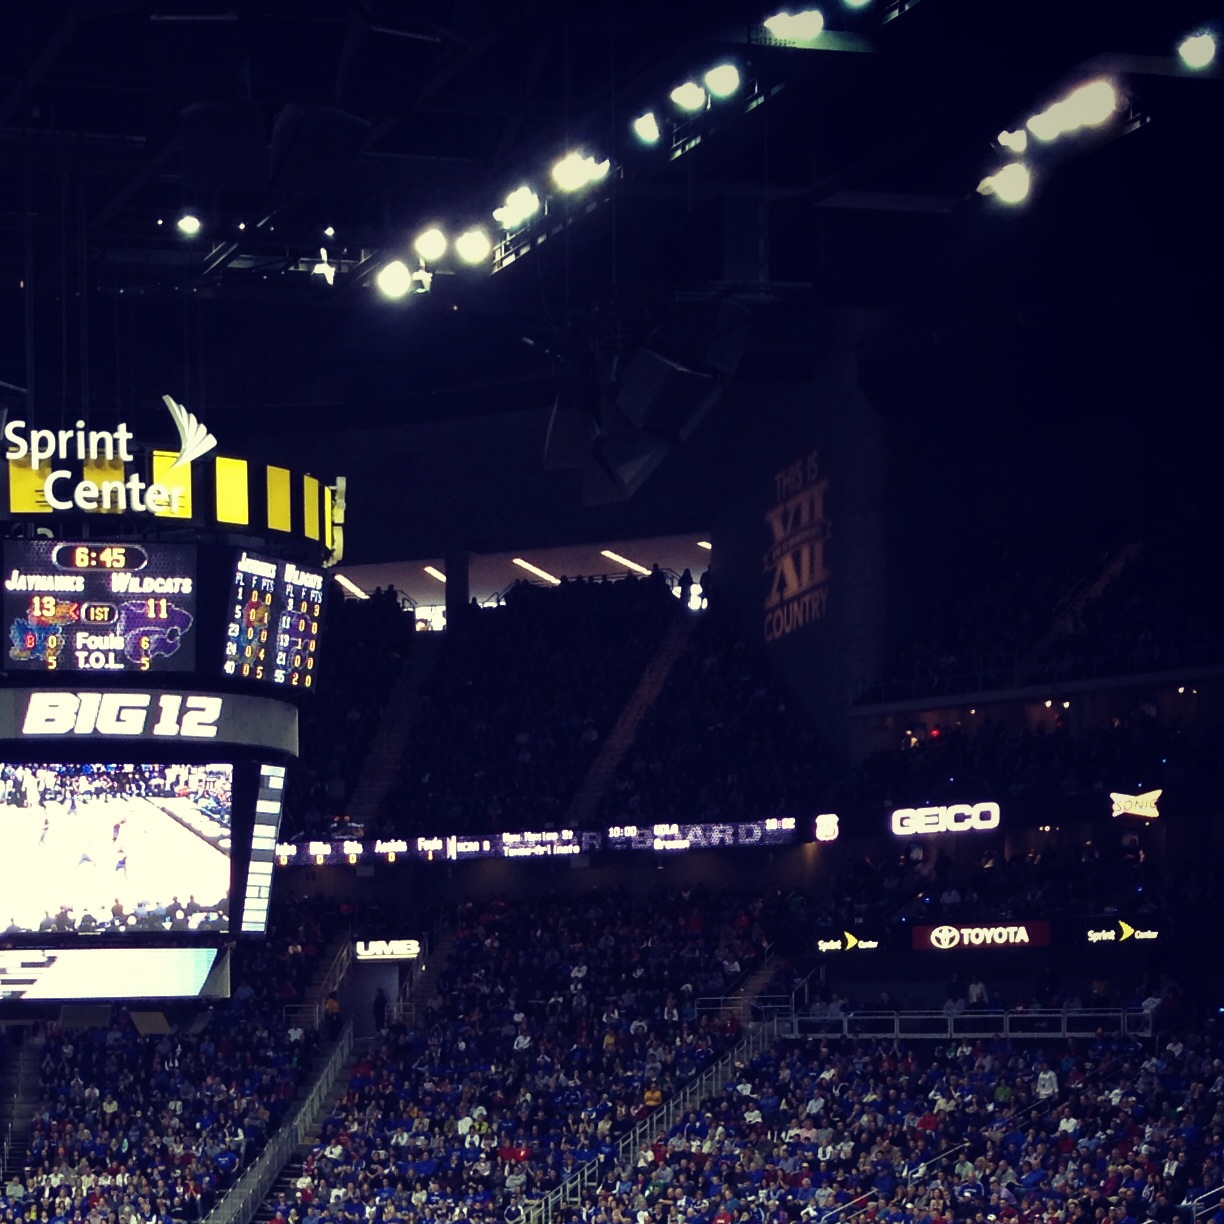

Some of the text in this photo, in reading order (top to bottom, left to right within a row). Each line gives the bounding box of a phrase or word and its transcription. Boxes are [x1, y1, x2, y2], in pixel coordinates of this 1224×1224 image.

[4, 420, 133, 470] Sprint
[44, 471, 184, 514] Center
[75, 547, 125, 567] 6:45
[111, 572, 192, 593] WILDCATS
[32, 596, 56, 616] 13
[147, 598, 167, 618] 11
[48, 632, 149, 649] 0 Fouls 6
[48, 657, 56, 669] 5
[141, 658, 150, 670] 5
[22, 693, 222, 737] BIG 12
[1115, 799, 1158, 812] SONIC
[891, 802, 1000, 836] GEICO
[609, 826, 637, 837] 10:00
[961, 927, 1029, 945] TOYOTA
[1088, 930, 1115, 943] Sprint
[357, 940, 420, 956] UMB
[818, 940, 841, 952] Sprint
